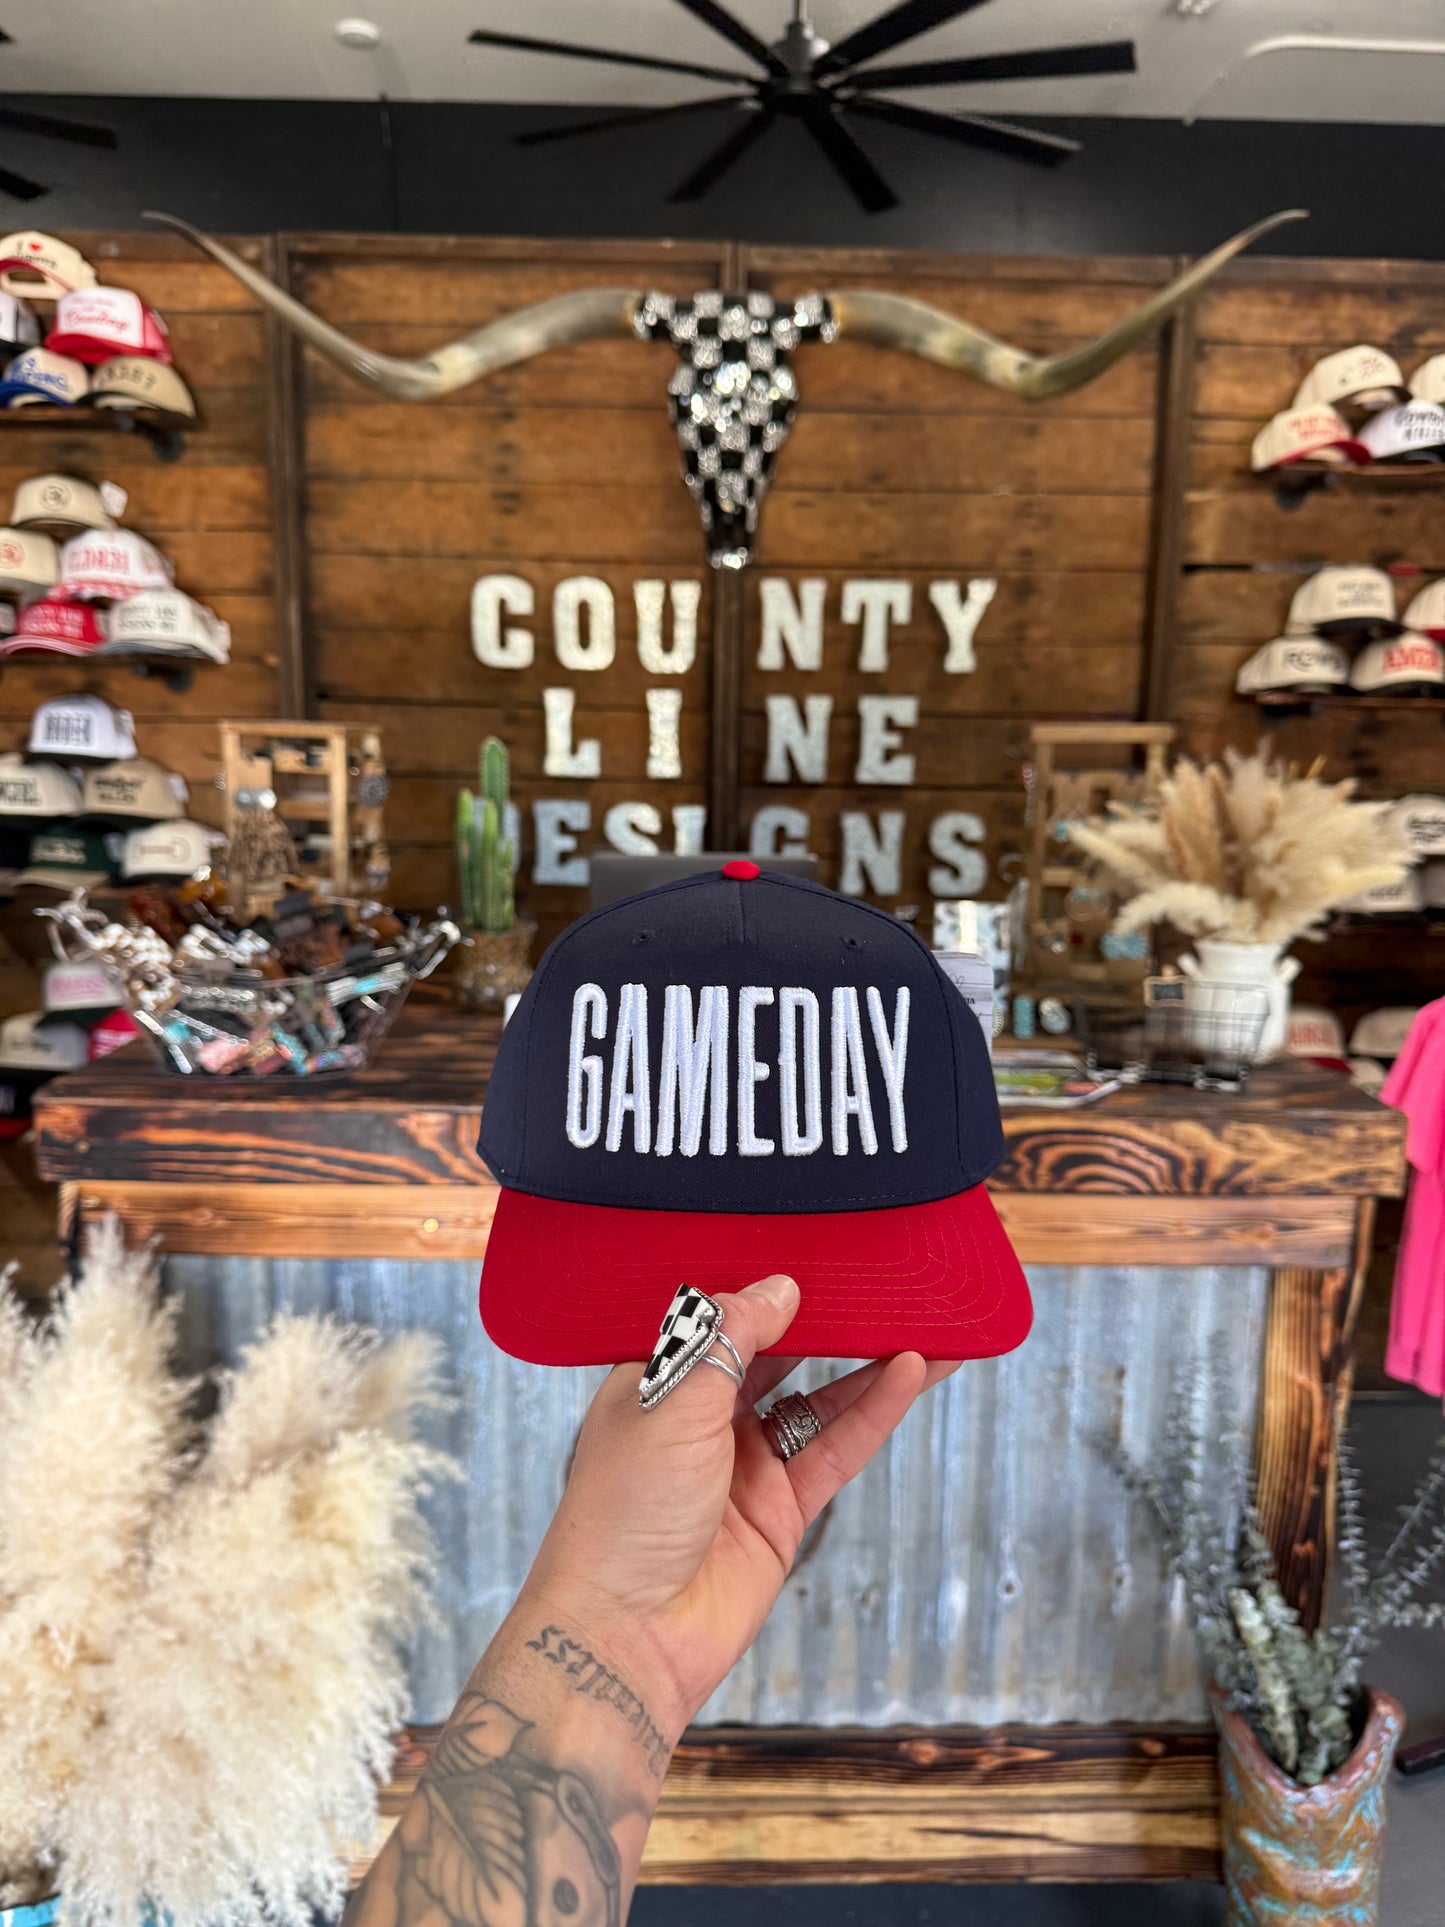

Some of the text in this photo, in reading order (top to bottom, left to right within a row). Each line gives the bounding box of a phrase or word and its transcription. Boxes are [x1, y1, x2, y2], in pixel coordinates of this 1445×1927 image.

[470, 574, 997, 673] COUNTY
[543, 687, 919, 784] LINE
[566, 982, 911, 1157] GAMEDAY
